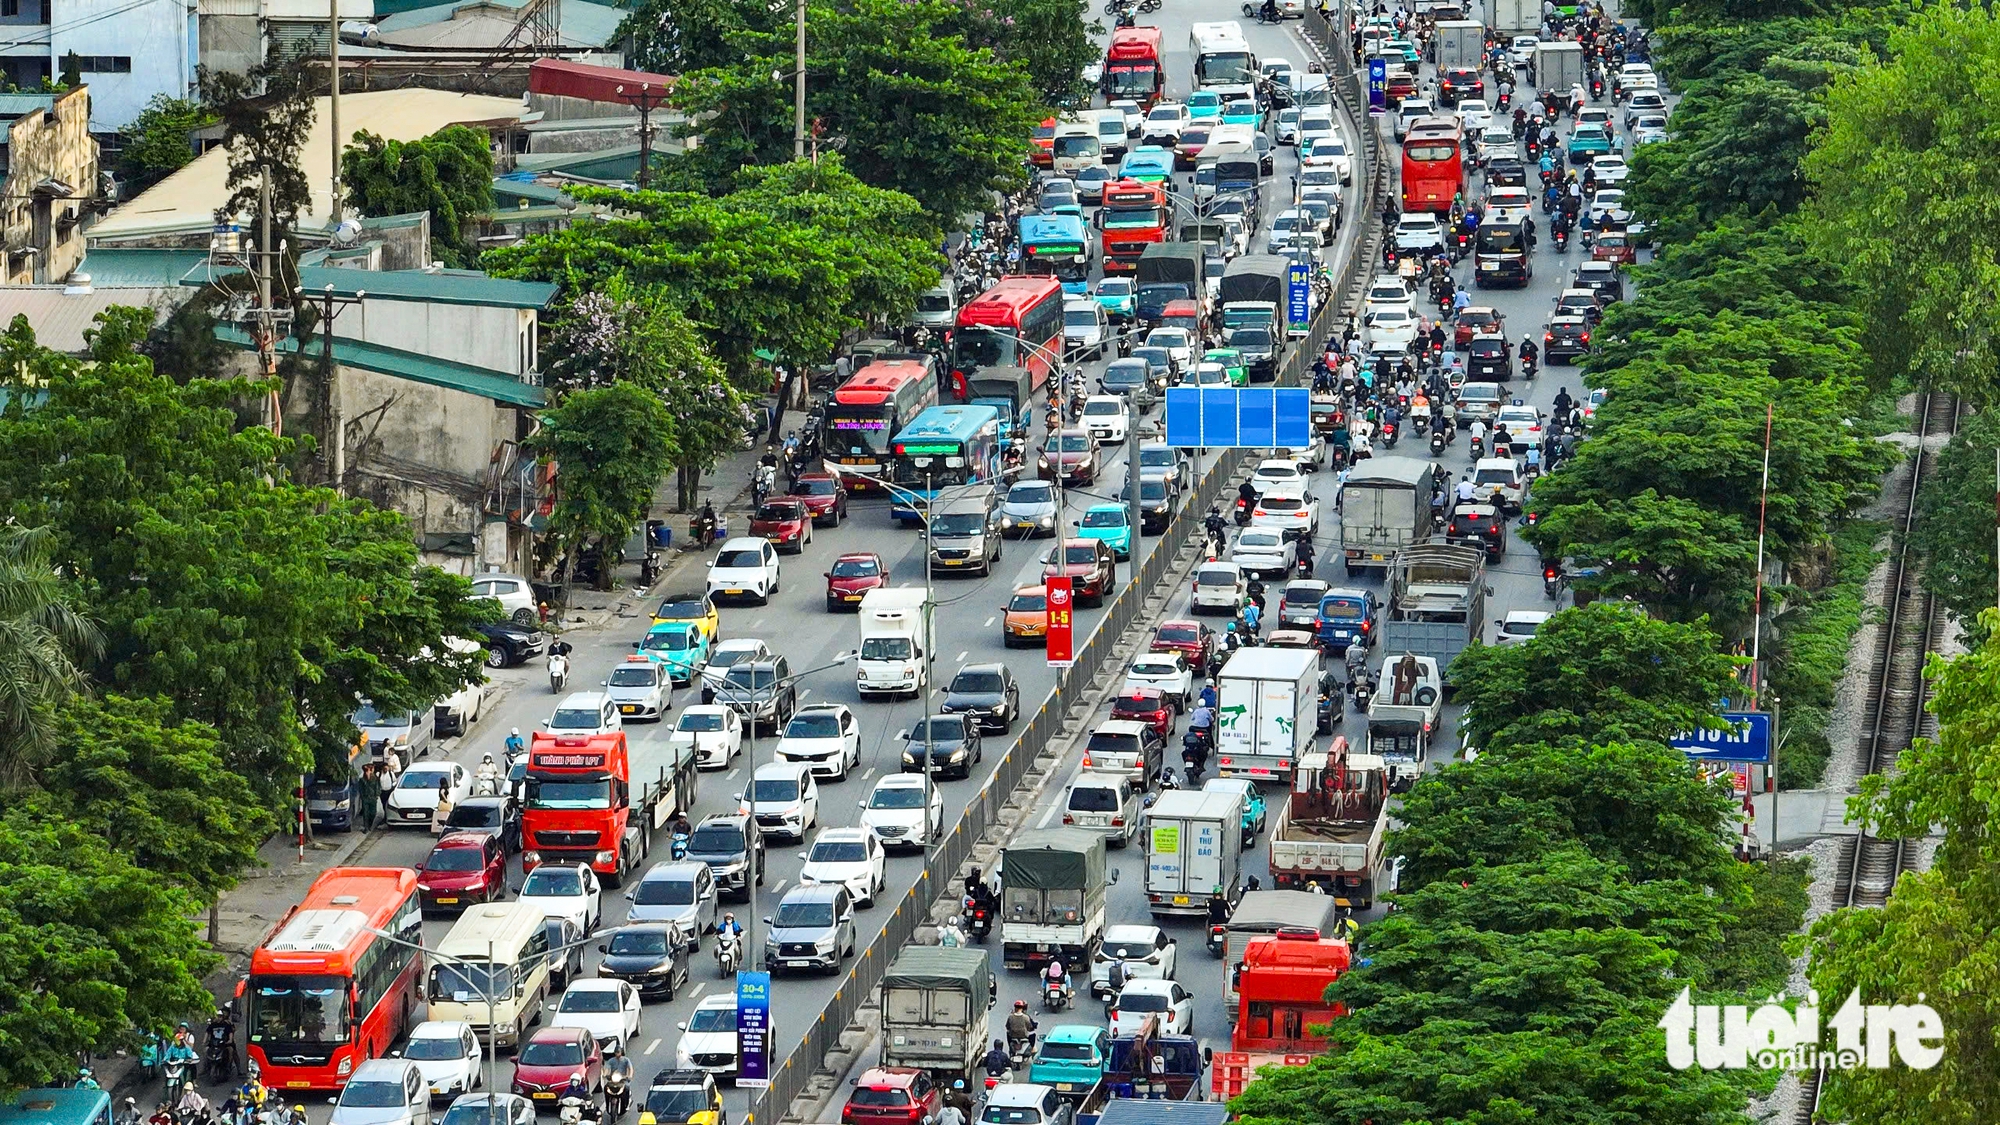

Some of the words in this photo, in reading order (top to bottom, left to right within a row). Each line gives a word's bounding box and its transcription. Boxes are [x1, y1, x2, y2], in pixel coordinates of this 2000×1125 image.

[1050, 611, 1069, 624] 1-5
[540, 754, 564, 765] THÀNH
[1202, 828, 1210, 836] XE
